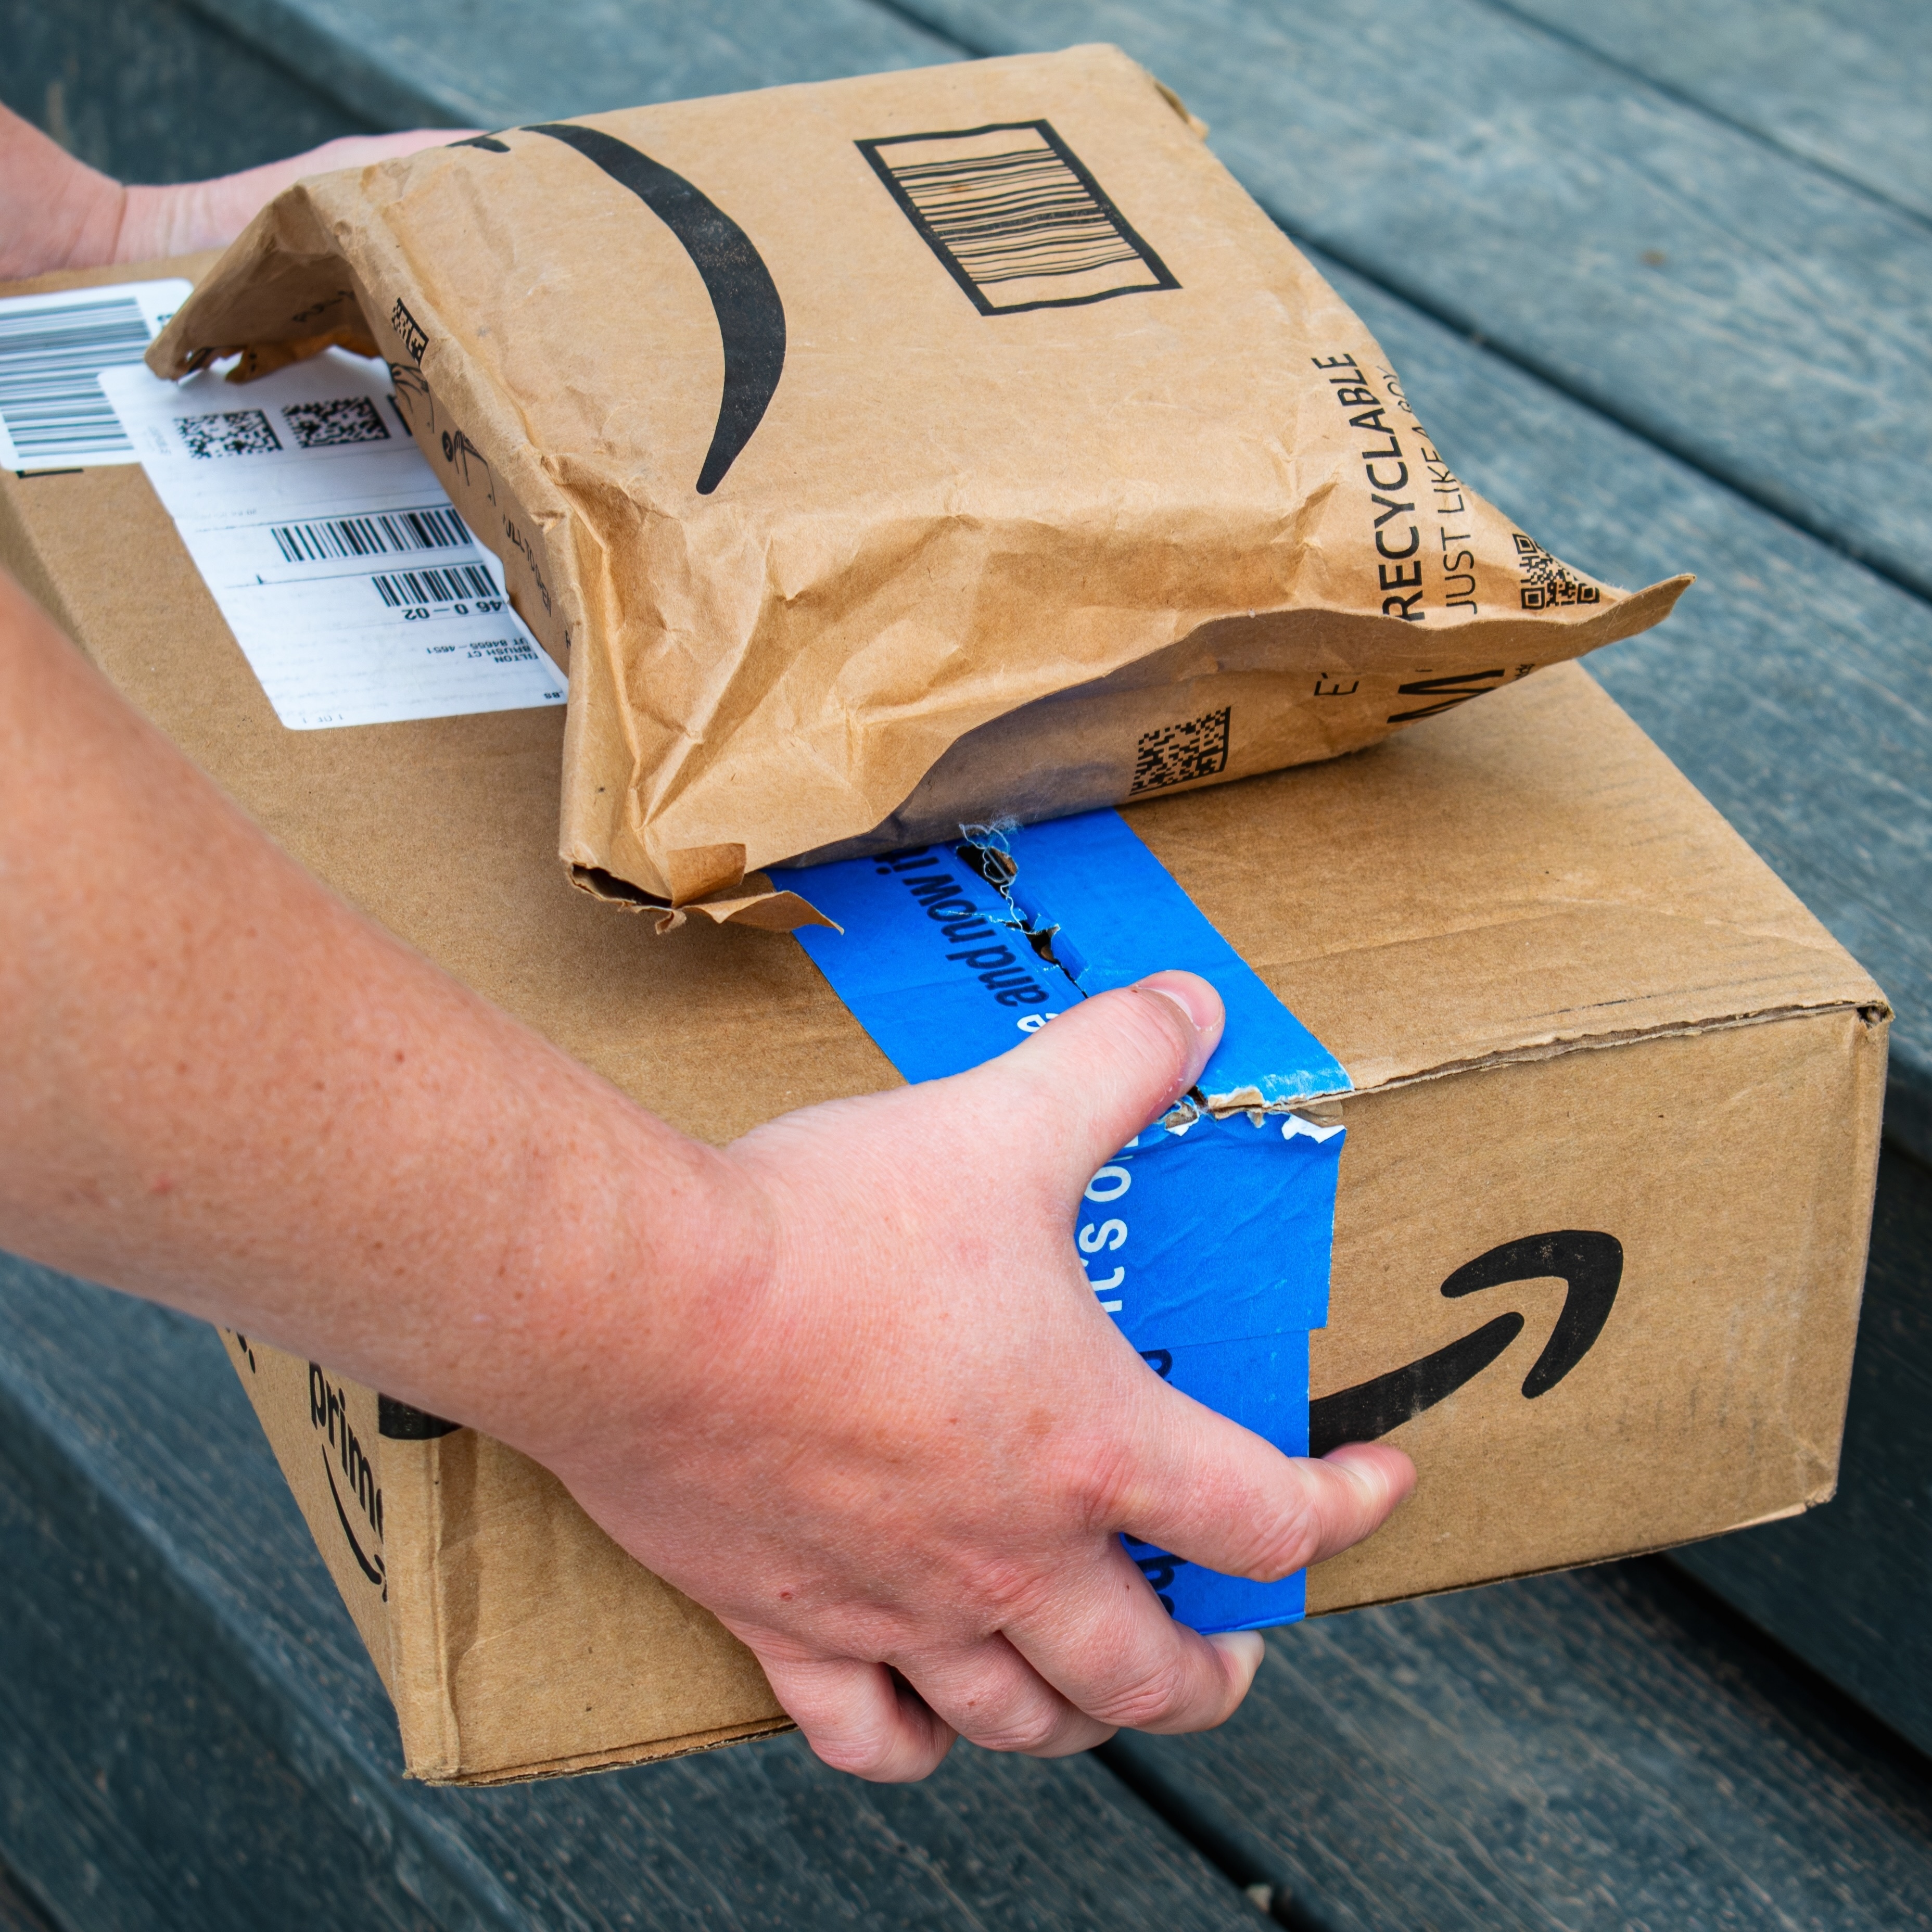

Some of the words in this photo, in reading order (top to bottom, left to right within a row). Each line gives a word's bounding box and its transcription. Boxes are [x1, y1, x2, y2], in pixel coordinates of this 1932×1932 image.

[1311, 352, 1426, 622] RECYCLABLE
[1421, 447, 1466, 514] LIKE
[1440, 527, 1478, 615] JUST
[467, 650, 482, 658] CT
[544, 691, 564, 700] BS
[901, 874, 998, 944] now
[945, 945, 1050, 1007] and
